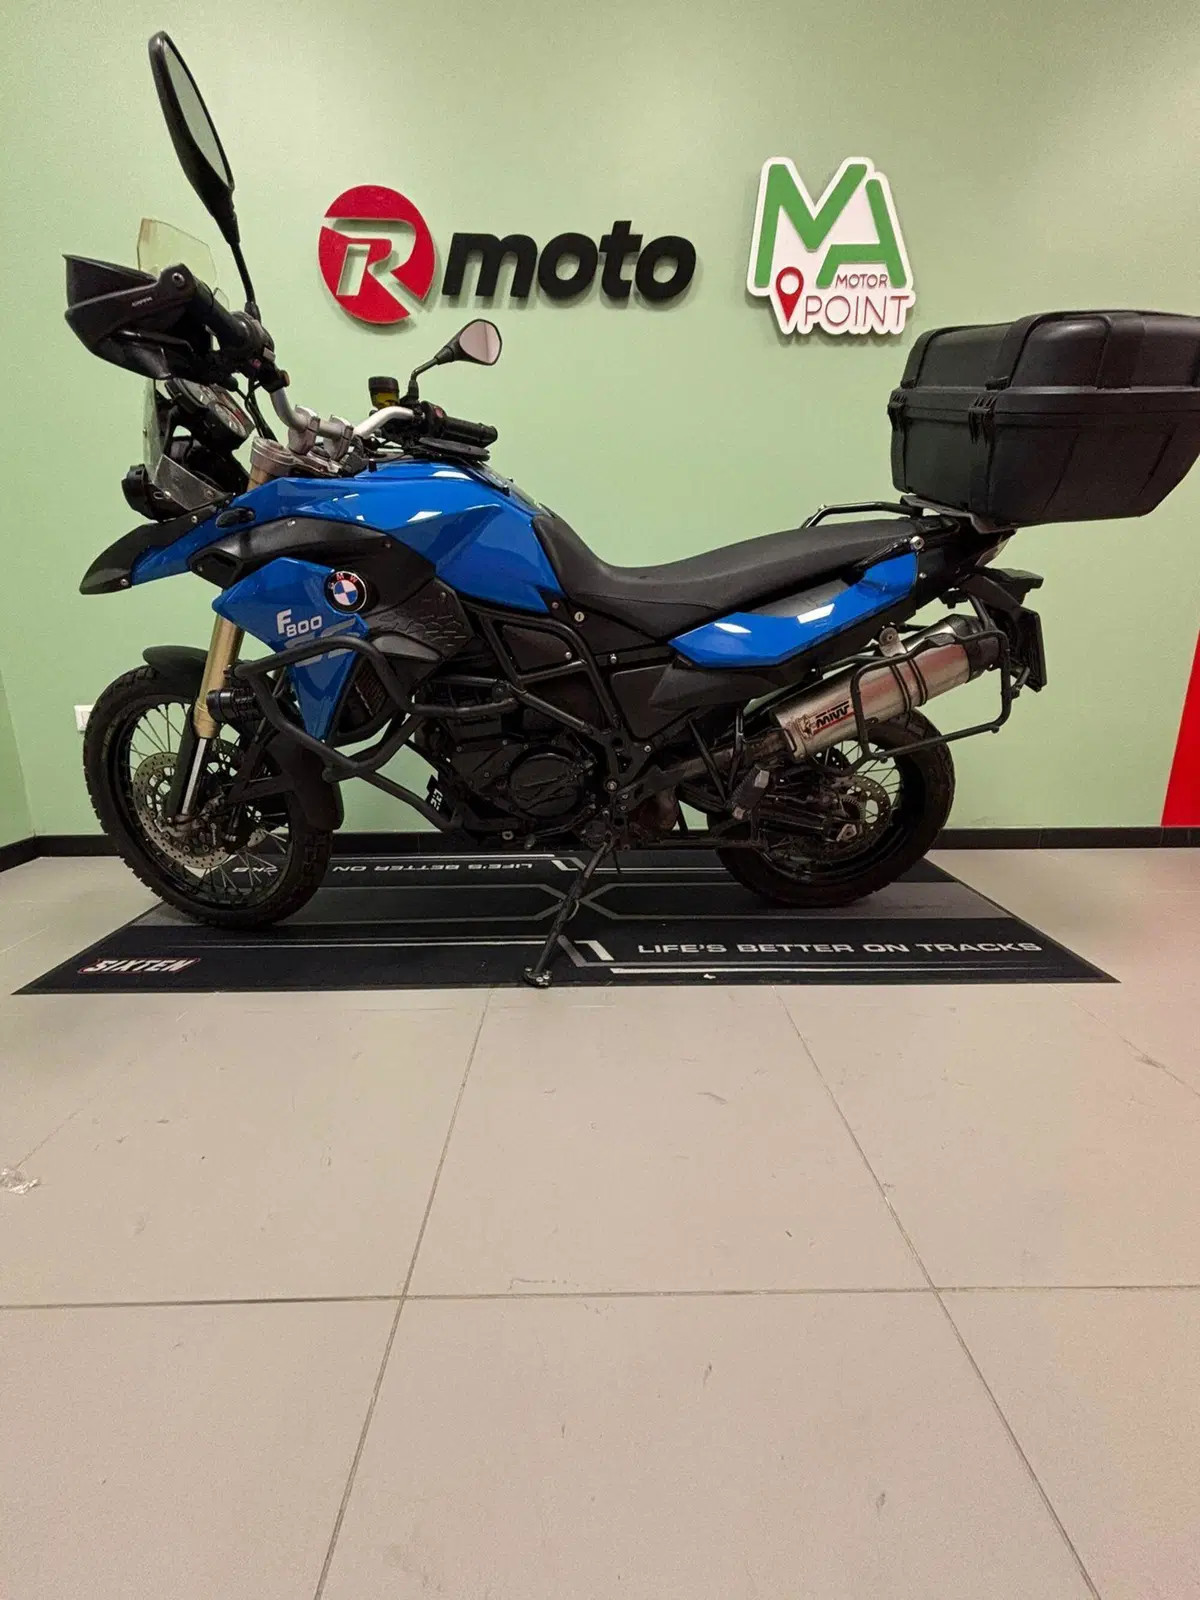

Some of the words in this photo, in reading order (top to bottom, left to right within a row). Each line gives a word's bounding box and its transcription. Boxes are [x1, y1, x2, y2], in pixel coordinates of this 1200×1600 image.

[441, 220, 697, 300] moto
[835, 274, 888, 289] MOTOR
[804, 295, 910, 327] POINT
[374, 863, 460, 872] BETTER
[637, 944, 728, 954] LIFE'S
[736, 943, 855, 953] BETTER
[862, 943, 910, 953] ON
[915, 942, 1043, 953] TRACKS
[82, 958, 198, 973] SIXTEN
